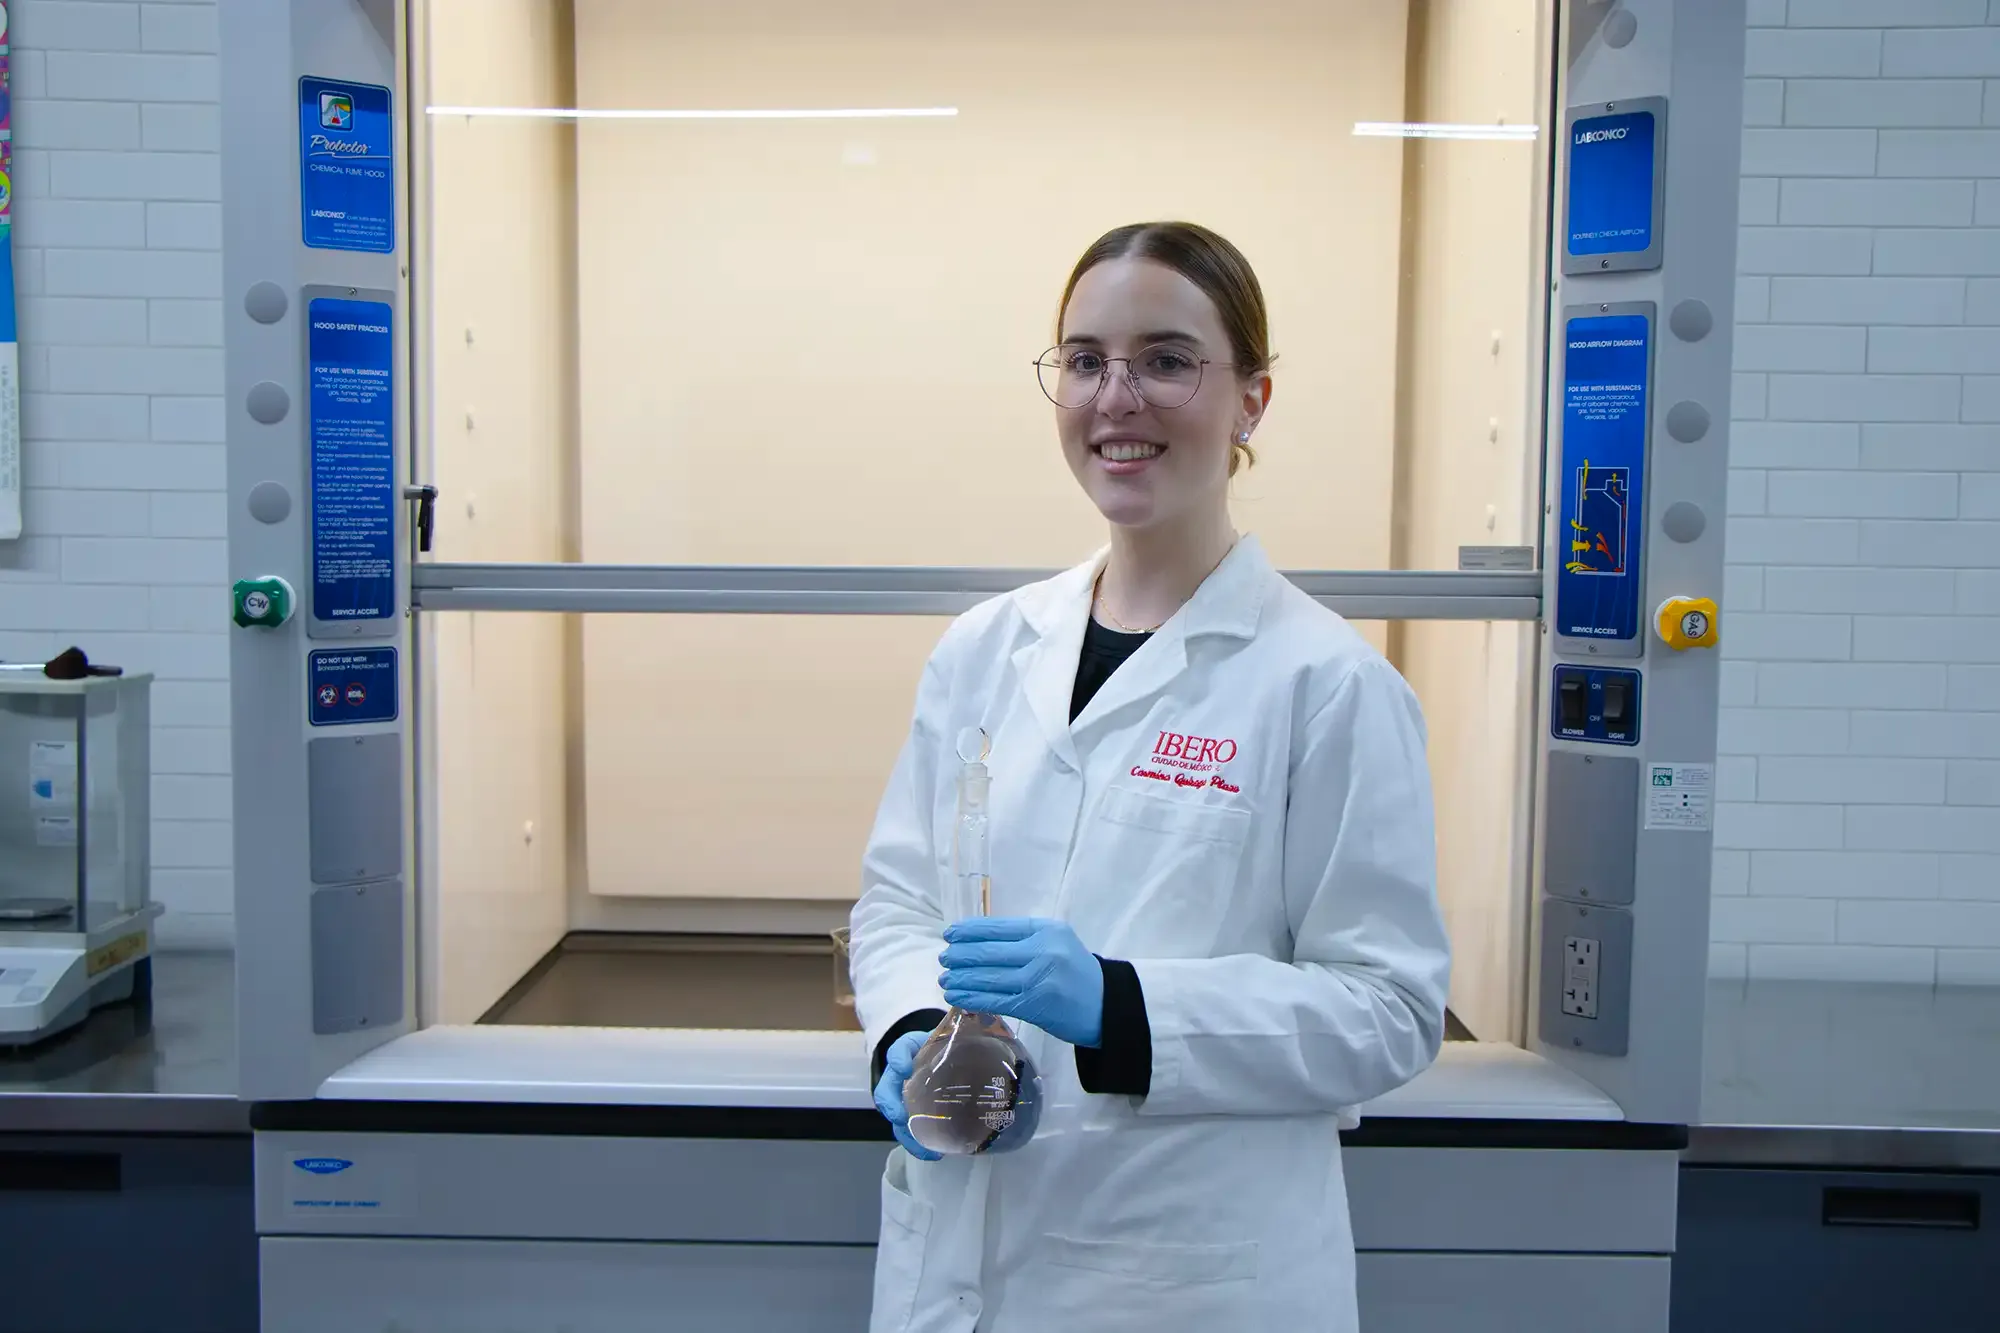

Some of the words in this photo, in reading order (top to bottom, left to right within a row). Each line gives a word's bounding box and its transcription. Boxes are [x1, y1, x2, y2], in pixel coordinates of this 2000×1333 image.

[1576, 128, 1628, 144] LABCONCO
[310, 135, 369, 154] Protector
[310, 164, 344, 174] CHEMICAL
[346, 168, 363, 176] FUME
[364, 170, 385, 178] HOOD
[311, 210, 345, 219] LABCONCO
[1573, 232, 1598, 240] ROUTINELY
[315, 322, 335, 330] HOOD
[337, 323, 357, 331] SAFETY
[358, 325, 388, 333] PRACTICES
[248, 597, 269, 609] CW
[1594, 627, 1618, 635] ACCESS
[1688, 613, 1700, 637] GAS
[1152, 731, 1238, 763] IBERO
[1152, 756, 1179, 767] CIUDAD
[1189, 762, 1213, 772] MÉXICO
[992, 1077, 1005, 1087] 500
